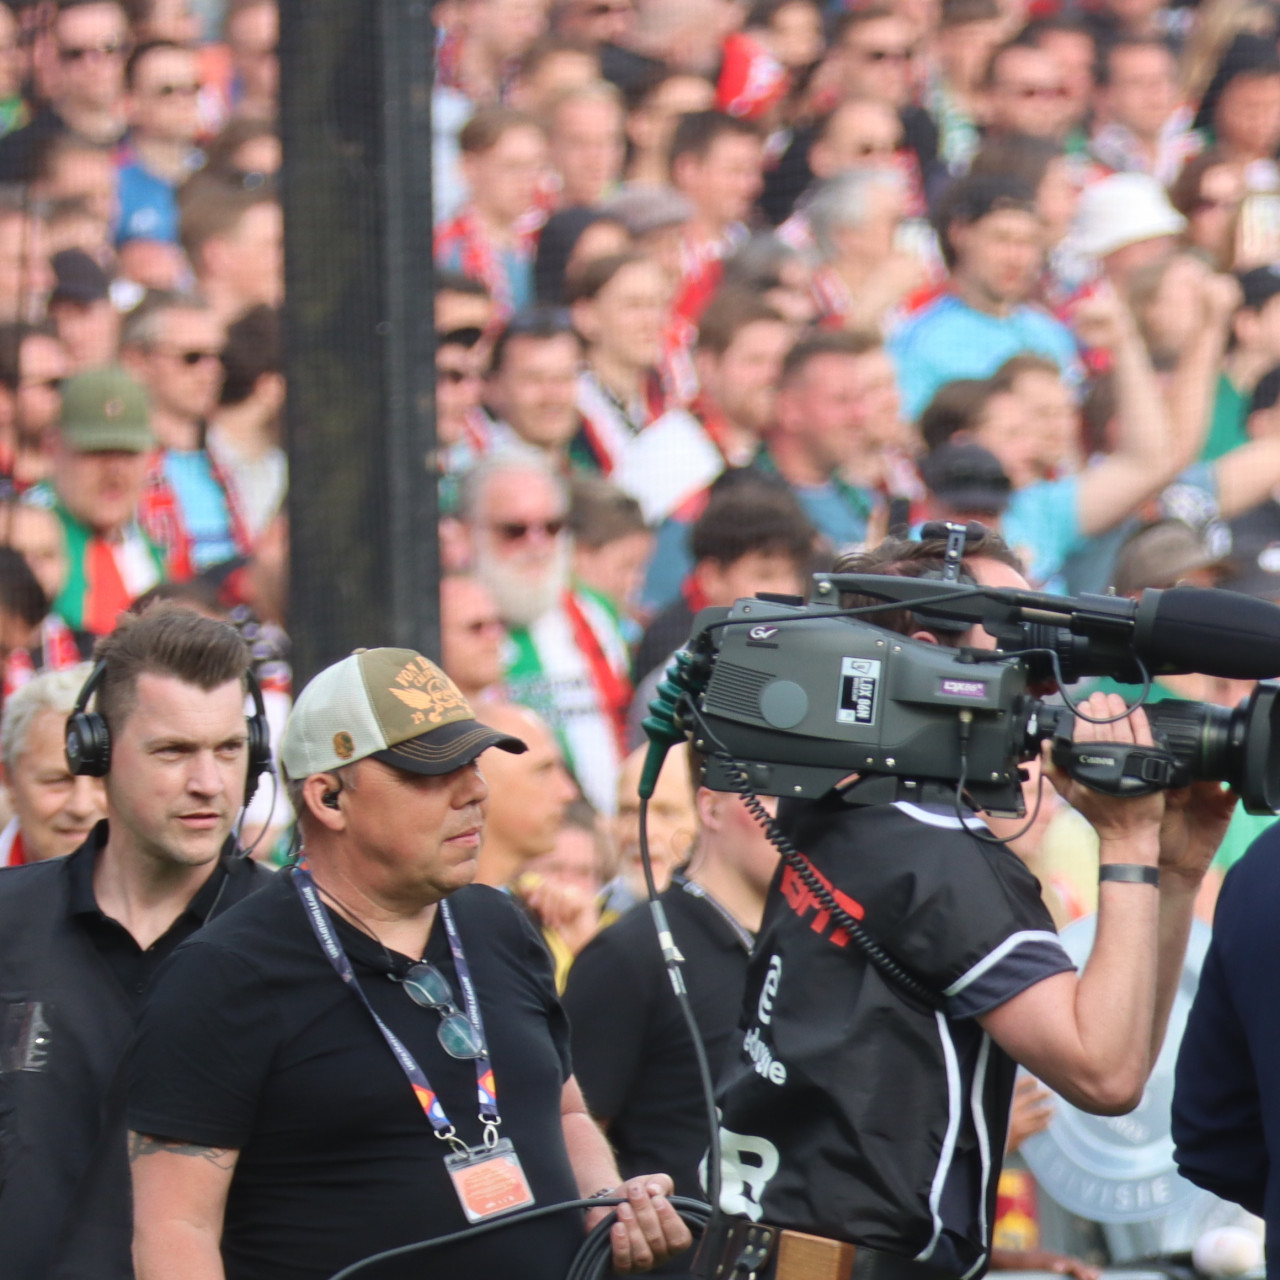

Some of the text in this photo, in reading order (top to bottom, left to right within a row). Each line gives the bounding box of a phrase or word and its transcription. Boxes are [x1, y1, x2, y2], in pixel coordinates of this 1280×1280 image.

[1078, 754, 1115, 767] Canon
[300, 884, 320, 911] LEAGUE
[311, 907, 332, 941] NATIONS
